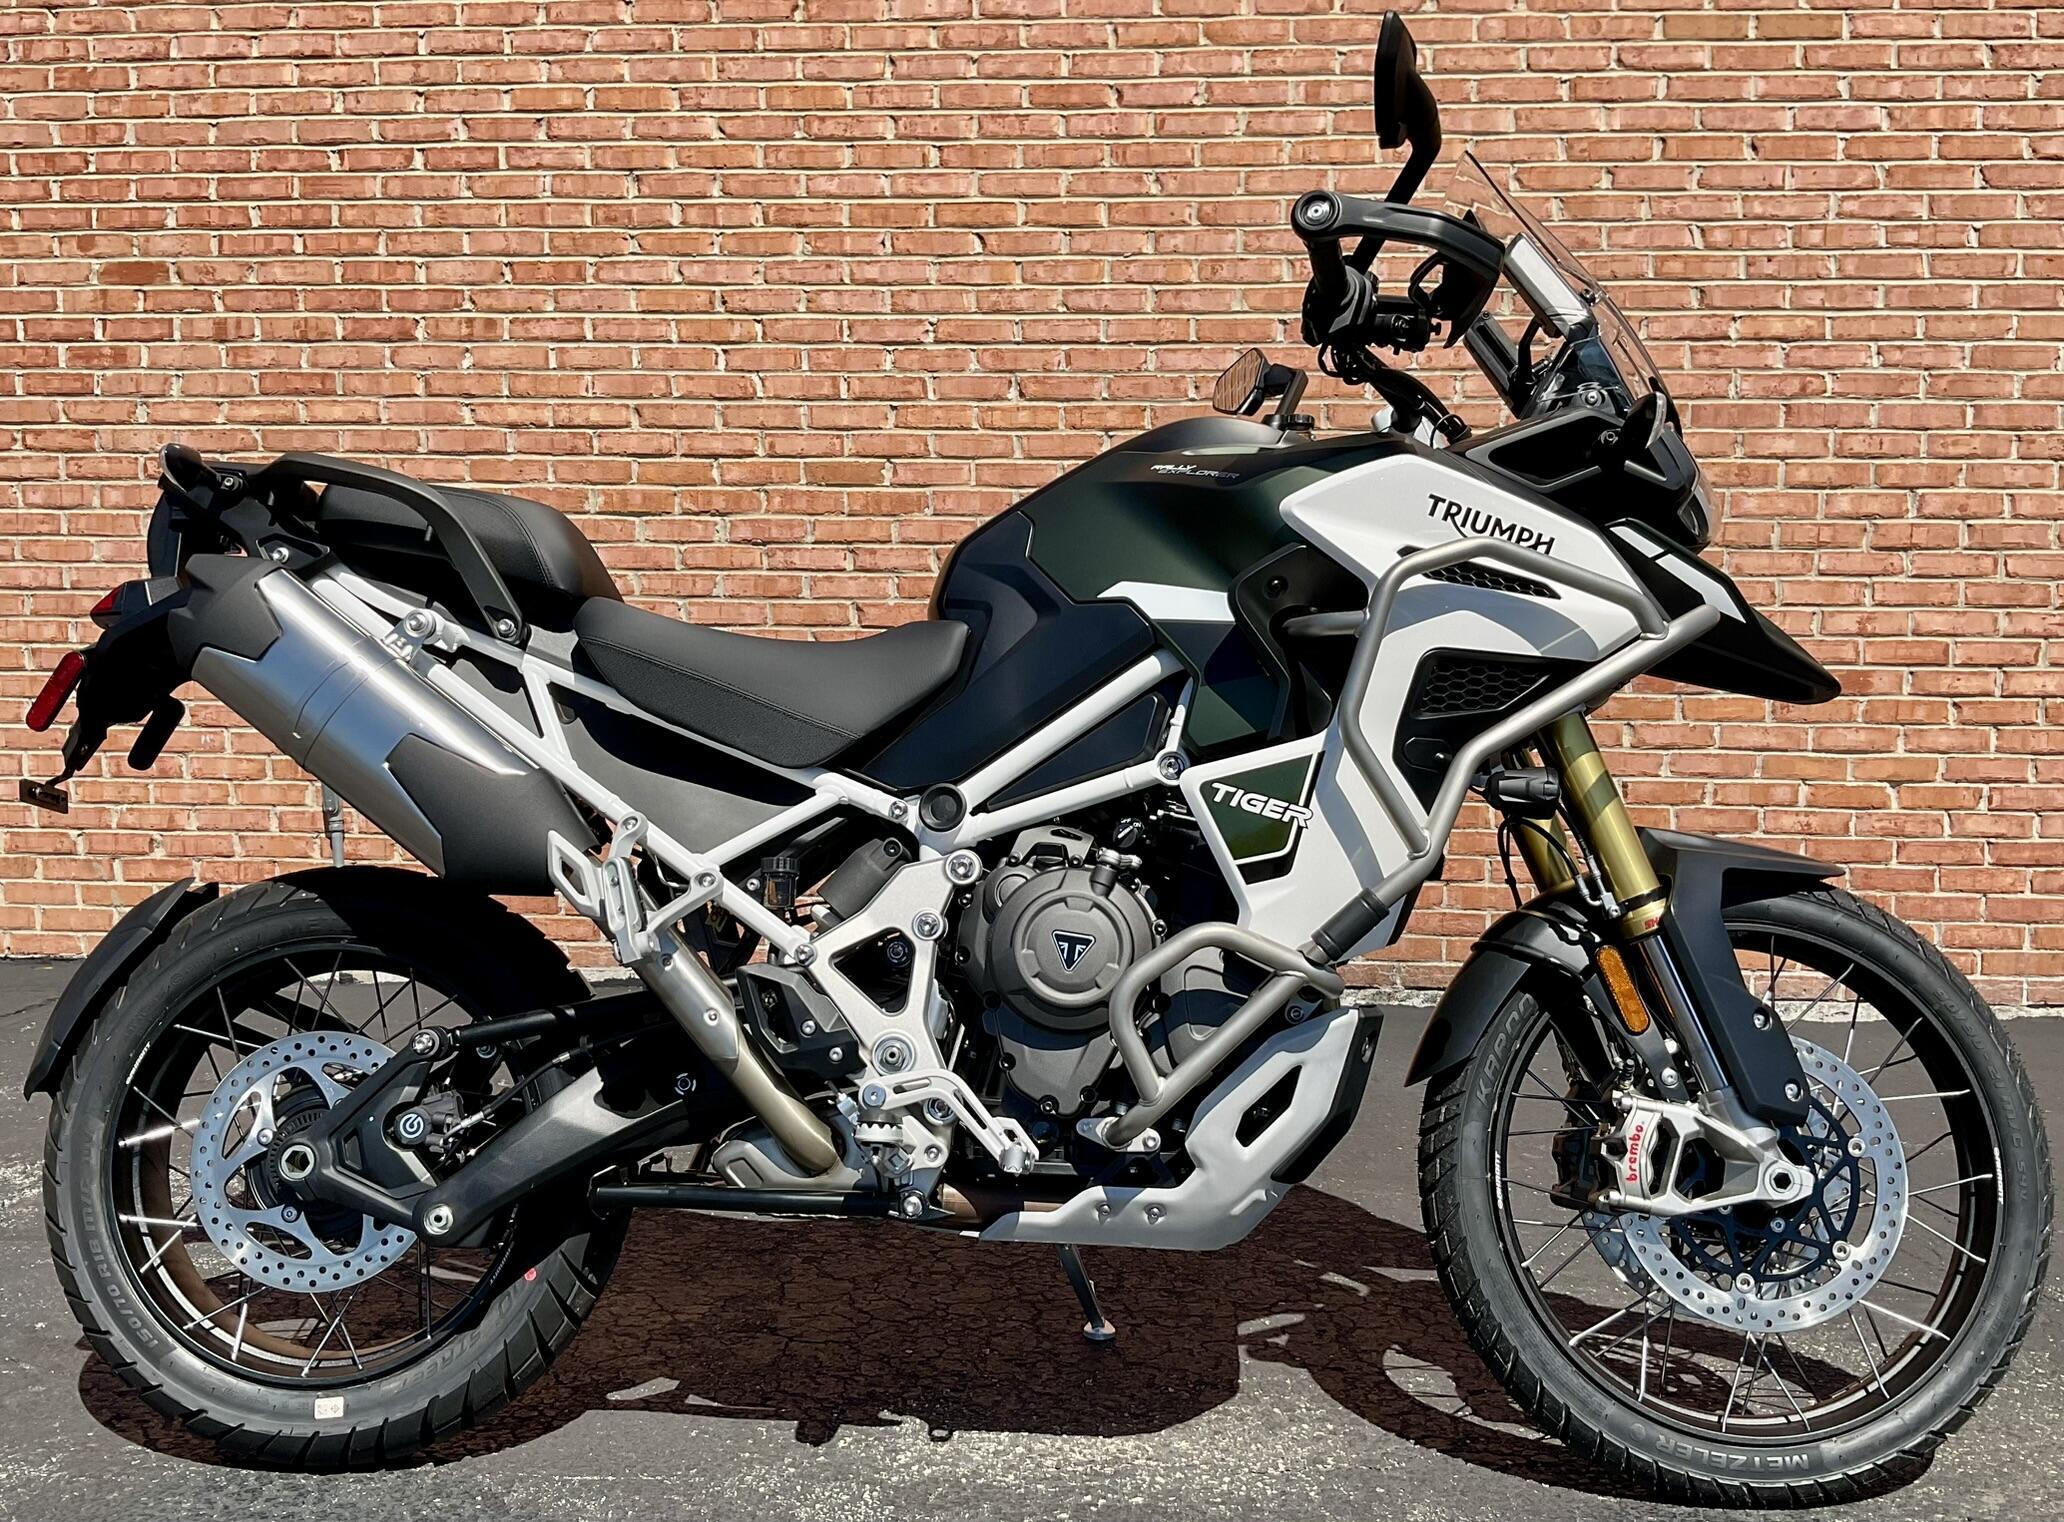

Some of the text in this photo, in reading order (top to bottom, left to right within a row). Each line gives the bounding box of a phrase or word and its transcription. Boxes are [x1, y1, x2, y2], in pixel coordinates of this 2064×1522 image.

[1427, 492, 1556, 556] TRIUMPH
[1210, 781, 1314, 830] TIGER
[1625, 1124, 1645, 1182] brembo
[1655, 1434, 1810, 1472] METZELER
